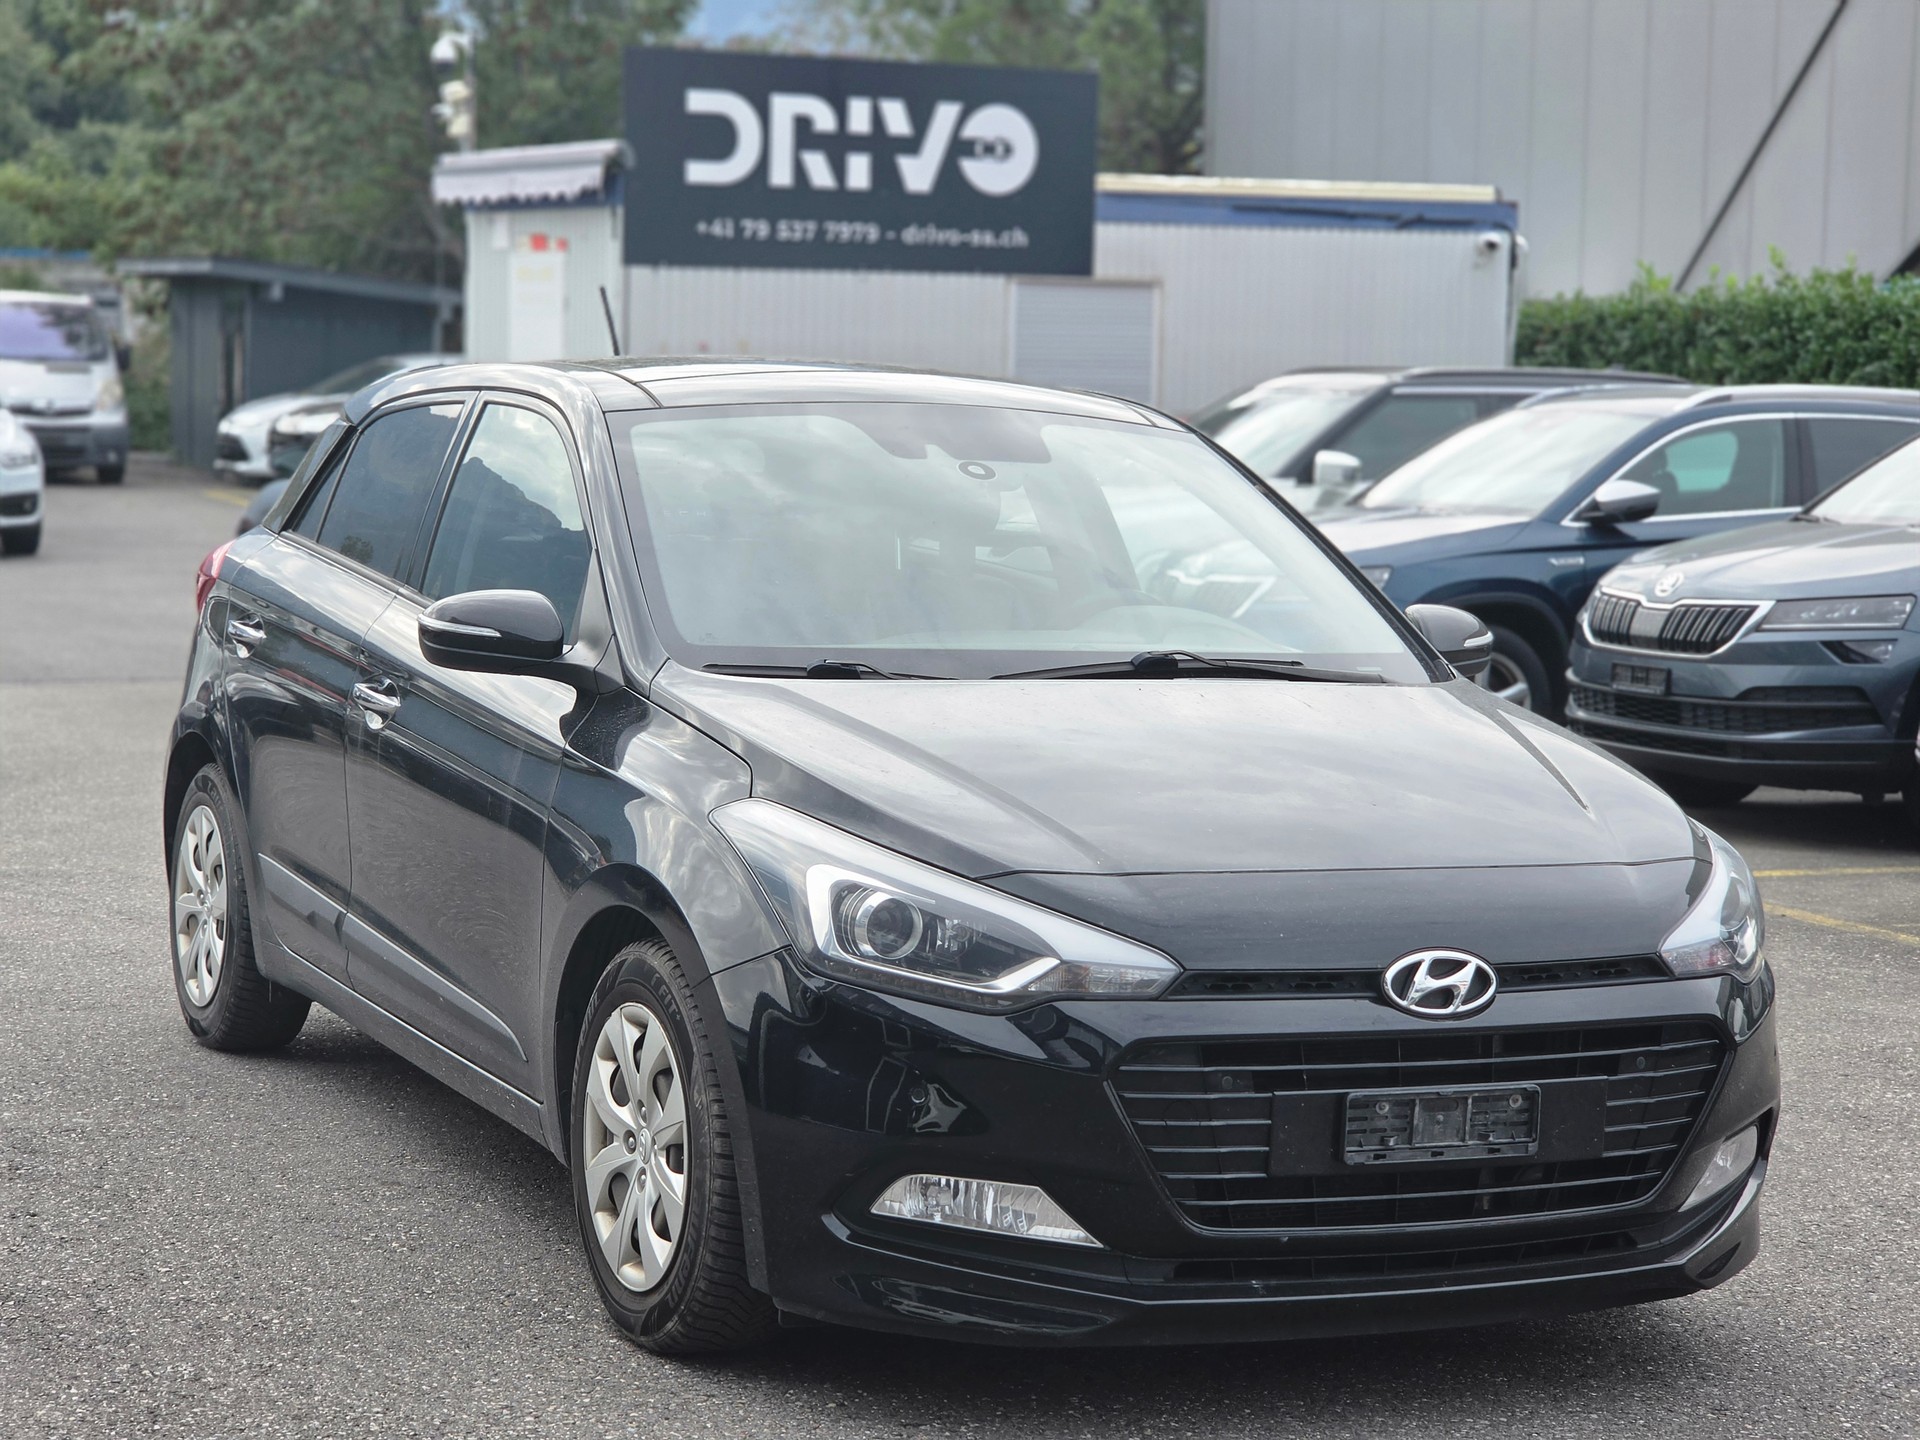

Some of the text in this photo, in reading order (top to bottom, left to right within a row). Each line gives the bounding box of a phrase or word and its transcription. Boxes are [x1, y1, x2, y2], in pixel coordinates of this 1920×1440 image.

[684, 88, 1039, 197] DRIVO
[697, 217, 735, 239] +41
[740, 218, 771, 241] 79
[776, 219, 818, 242] 537
[823, 220, 880, 244] 7979
